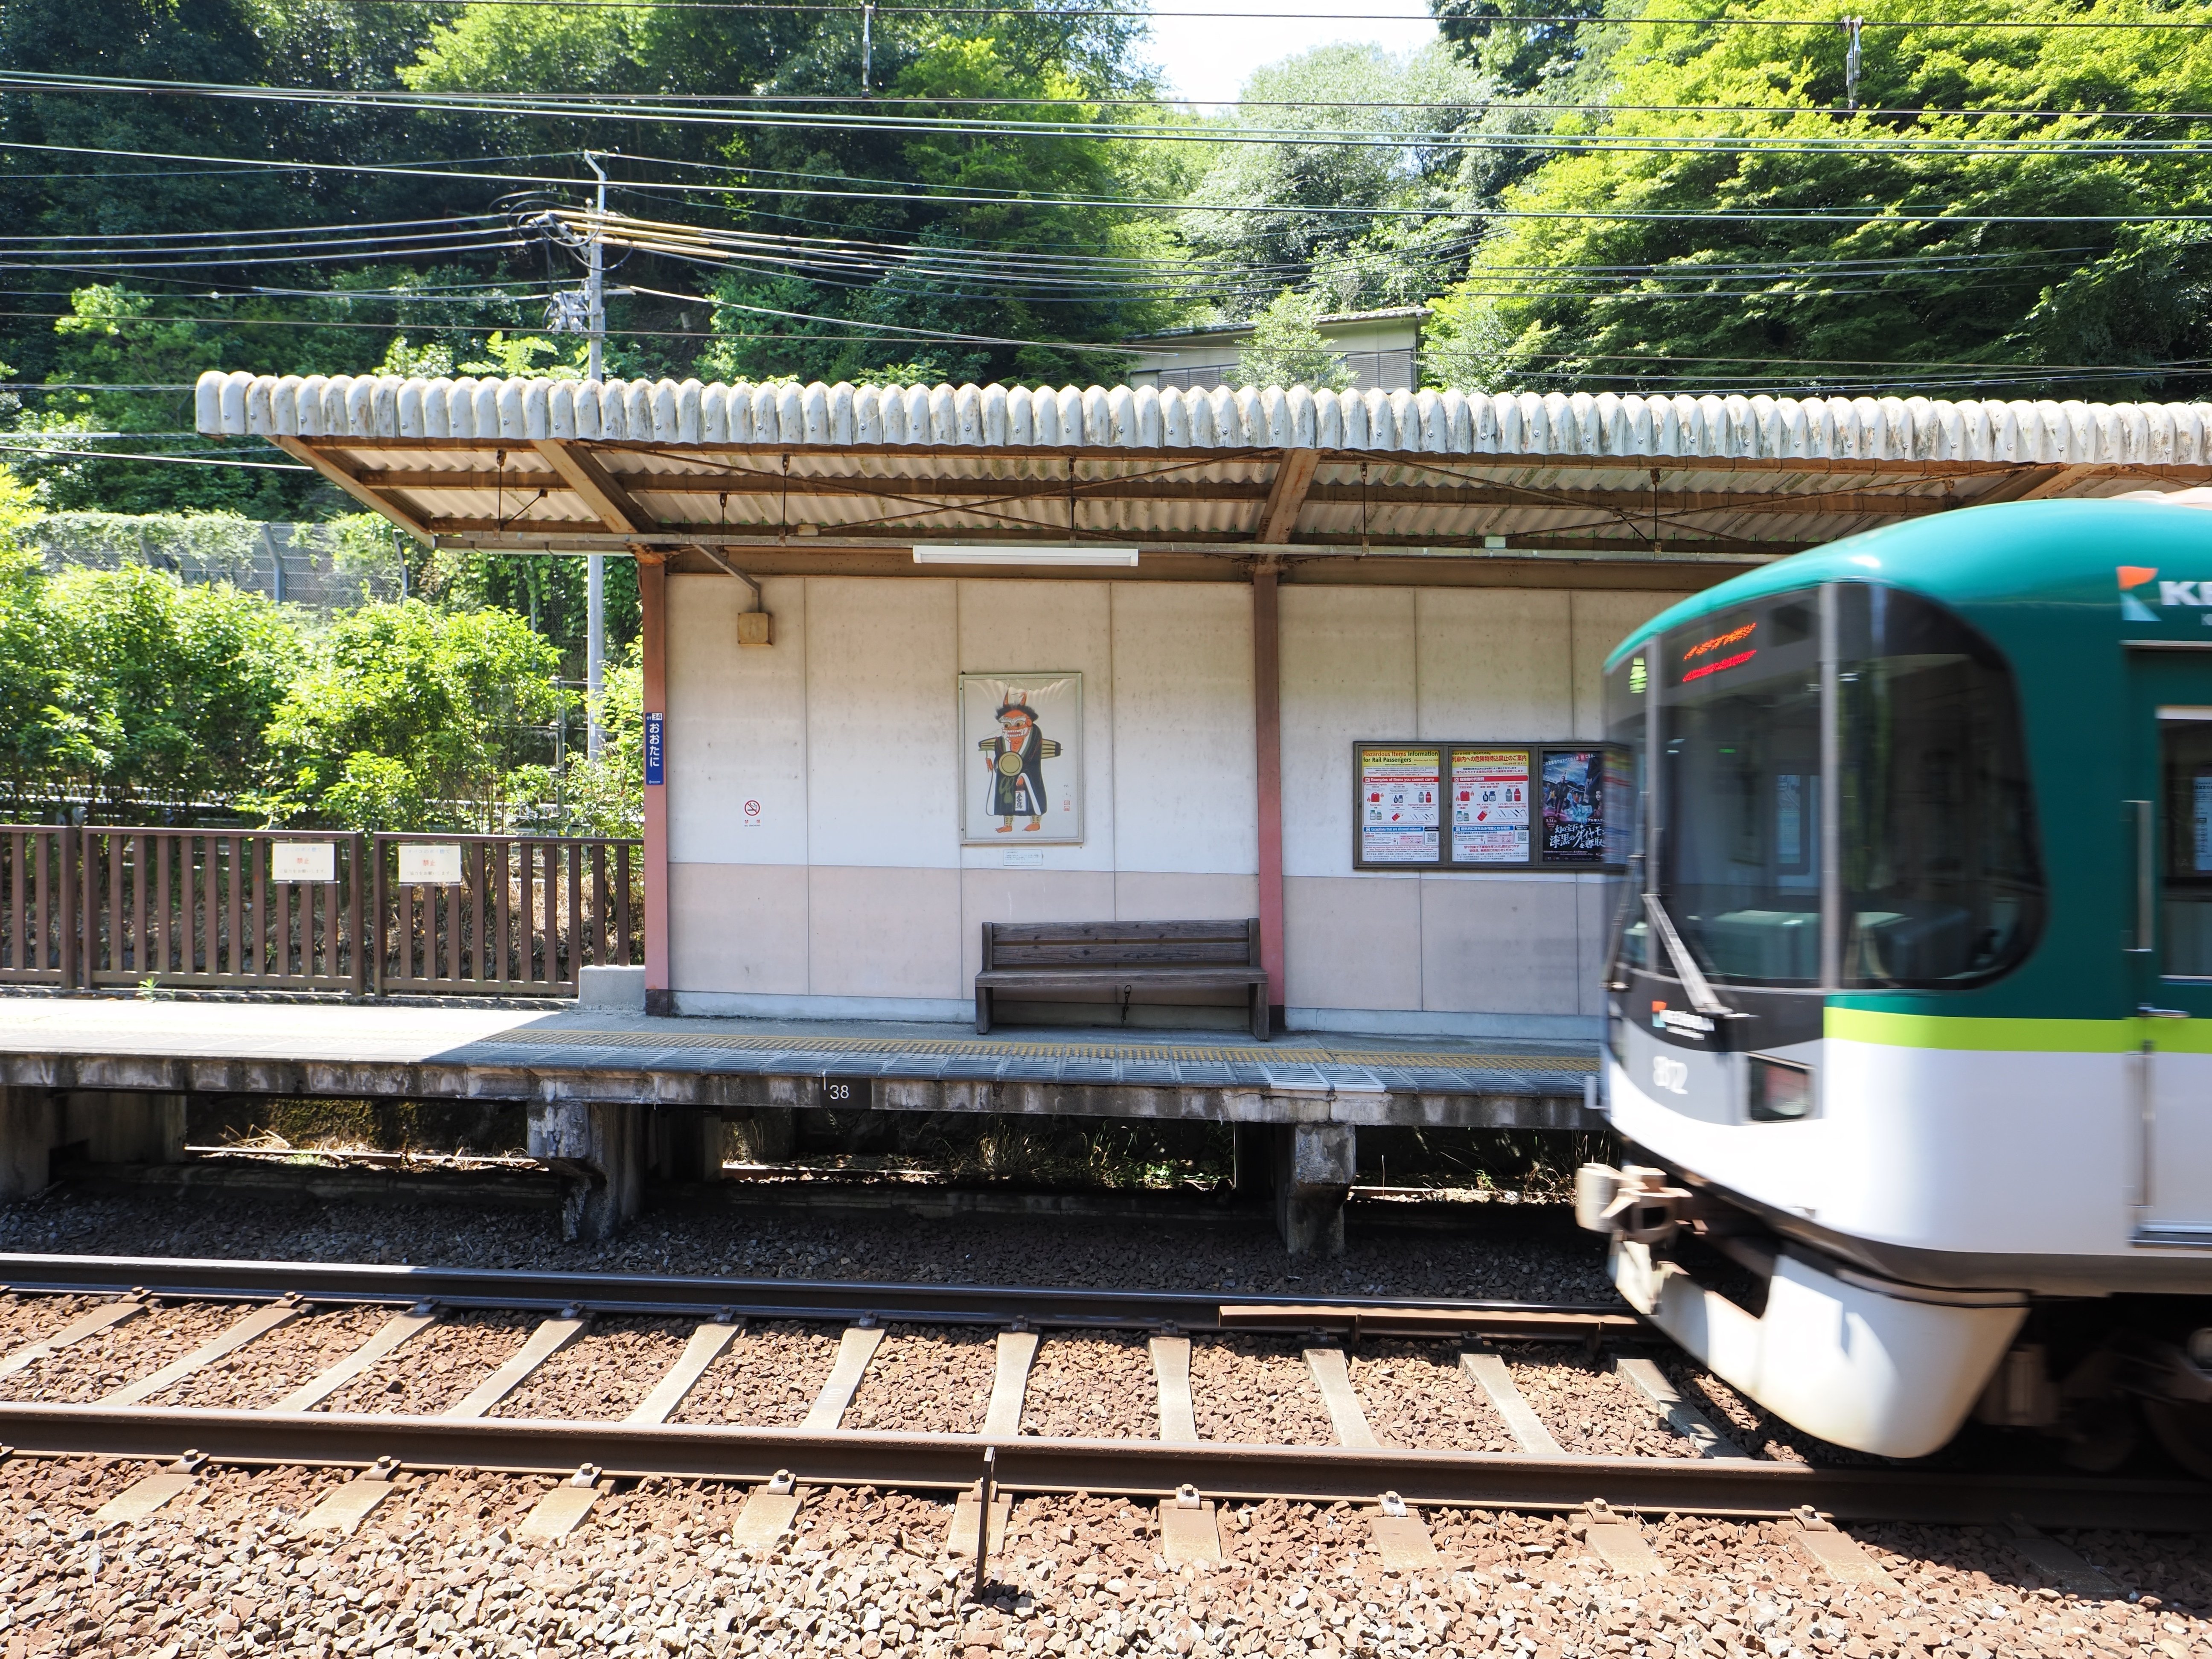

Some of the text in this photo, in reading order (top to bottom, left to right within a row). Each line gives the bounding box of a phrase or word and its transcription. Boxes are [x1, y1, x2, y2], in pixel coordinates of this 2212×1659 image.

[649, 723, 660, 767] おおたに
[1555, 824, 1578, 833] 幻の宝石
[830, 1085, 849, 1100] 38
